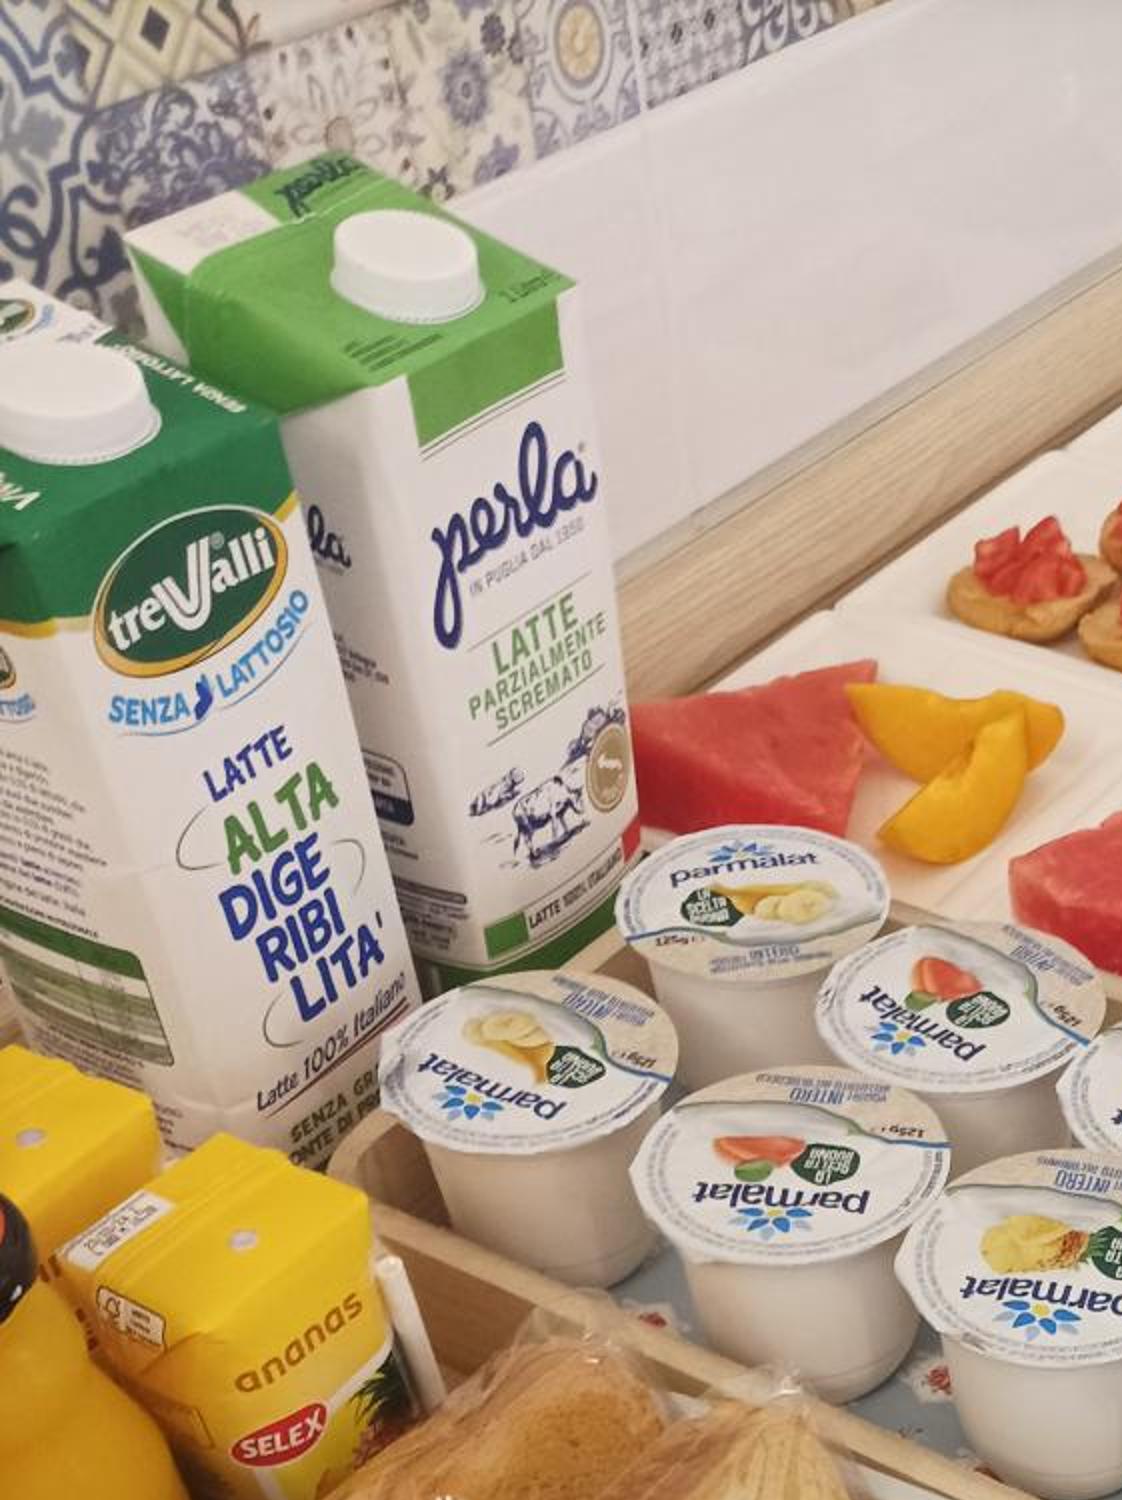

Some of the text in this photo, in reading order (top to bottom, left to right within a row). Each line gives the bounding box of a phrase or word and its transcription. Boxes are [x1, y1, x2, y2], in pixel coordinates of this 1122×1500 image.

[432, 421, 598, 650] perla
[108, 527, 275, 650] treValli
[108, 692, 190, 725] SENZA
[216, 590, 308, 697] LATTOSIO
[468, 611, 606, 719] PARZIALMENTE
[492, 592, 578, 676] LATTE
[495, 650, 592, 731] SCREMATO
[202, 725, 294, 803] LATTE
[221, 761, 340, 875] ALTA
[217, 831, 331, 940] DIGE
[670, 851, 818, 888] parmalat
[255, 886, 345, 983] RIBI
[528, 901, 561, 929] LATTE
[859, 986, 986, 1061] parmalat
[256, 1071, 299, 1111] Latte
[303, 1025, 350, 1081] 100%
[290, 1063, 380, 1144] SENZA GR
[417, 1053, 567, 1119] parmalat
[288, 1128, 334, 1167] ONTE
[1054, 1169, 1111, 1192] INTERO
[693, 1182, 870, 1214] parmalat
[234, 1292, 364, 1394] ananas
[239, 1408, 326, 1462] SELEX
